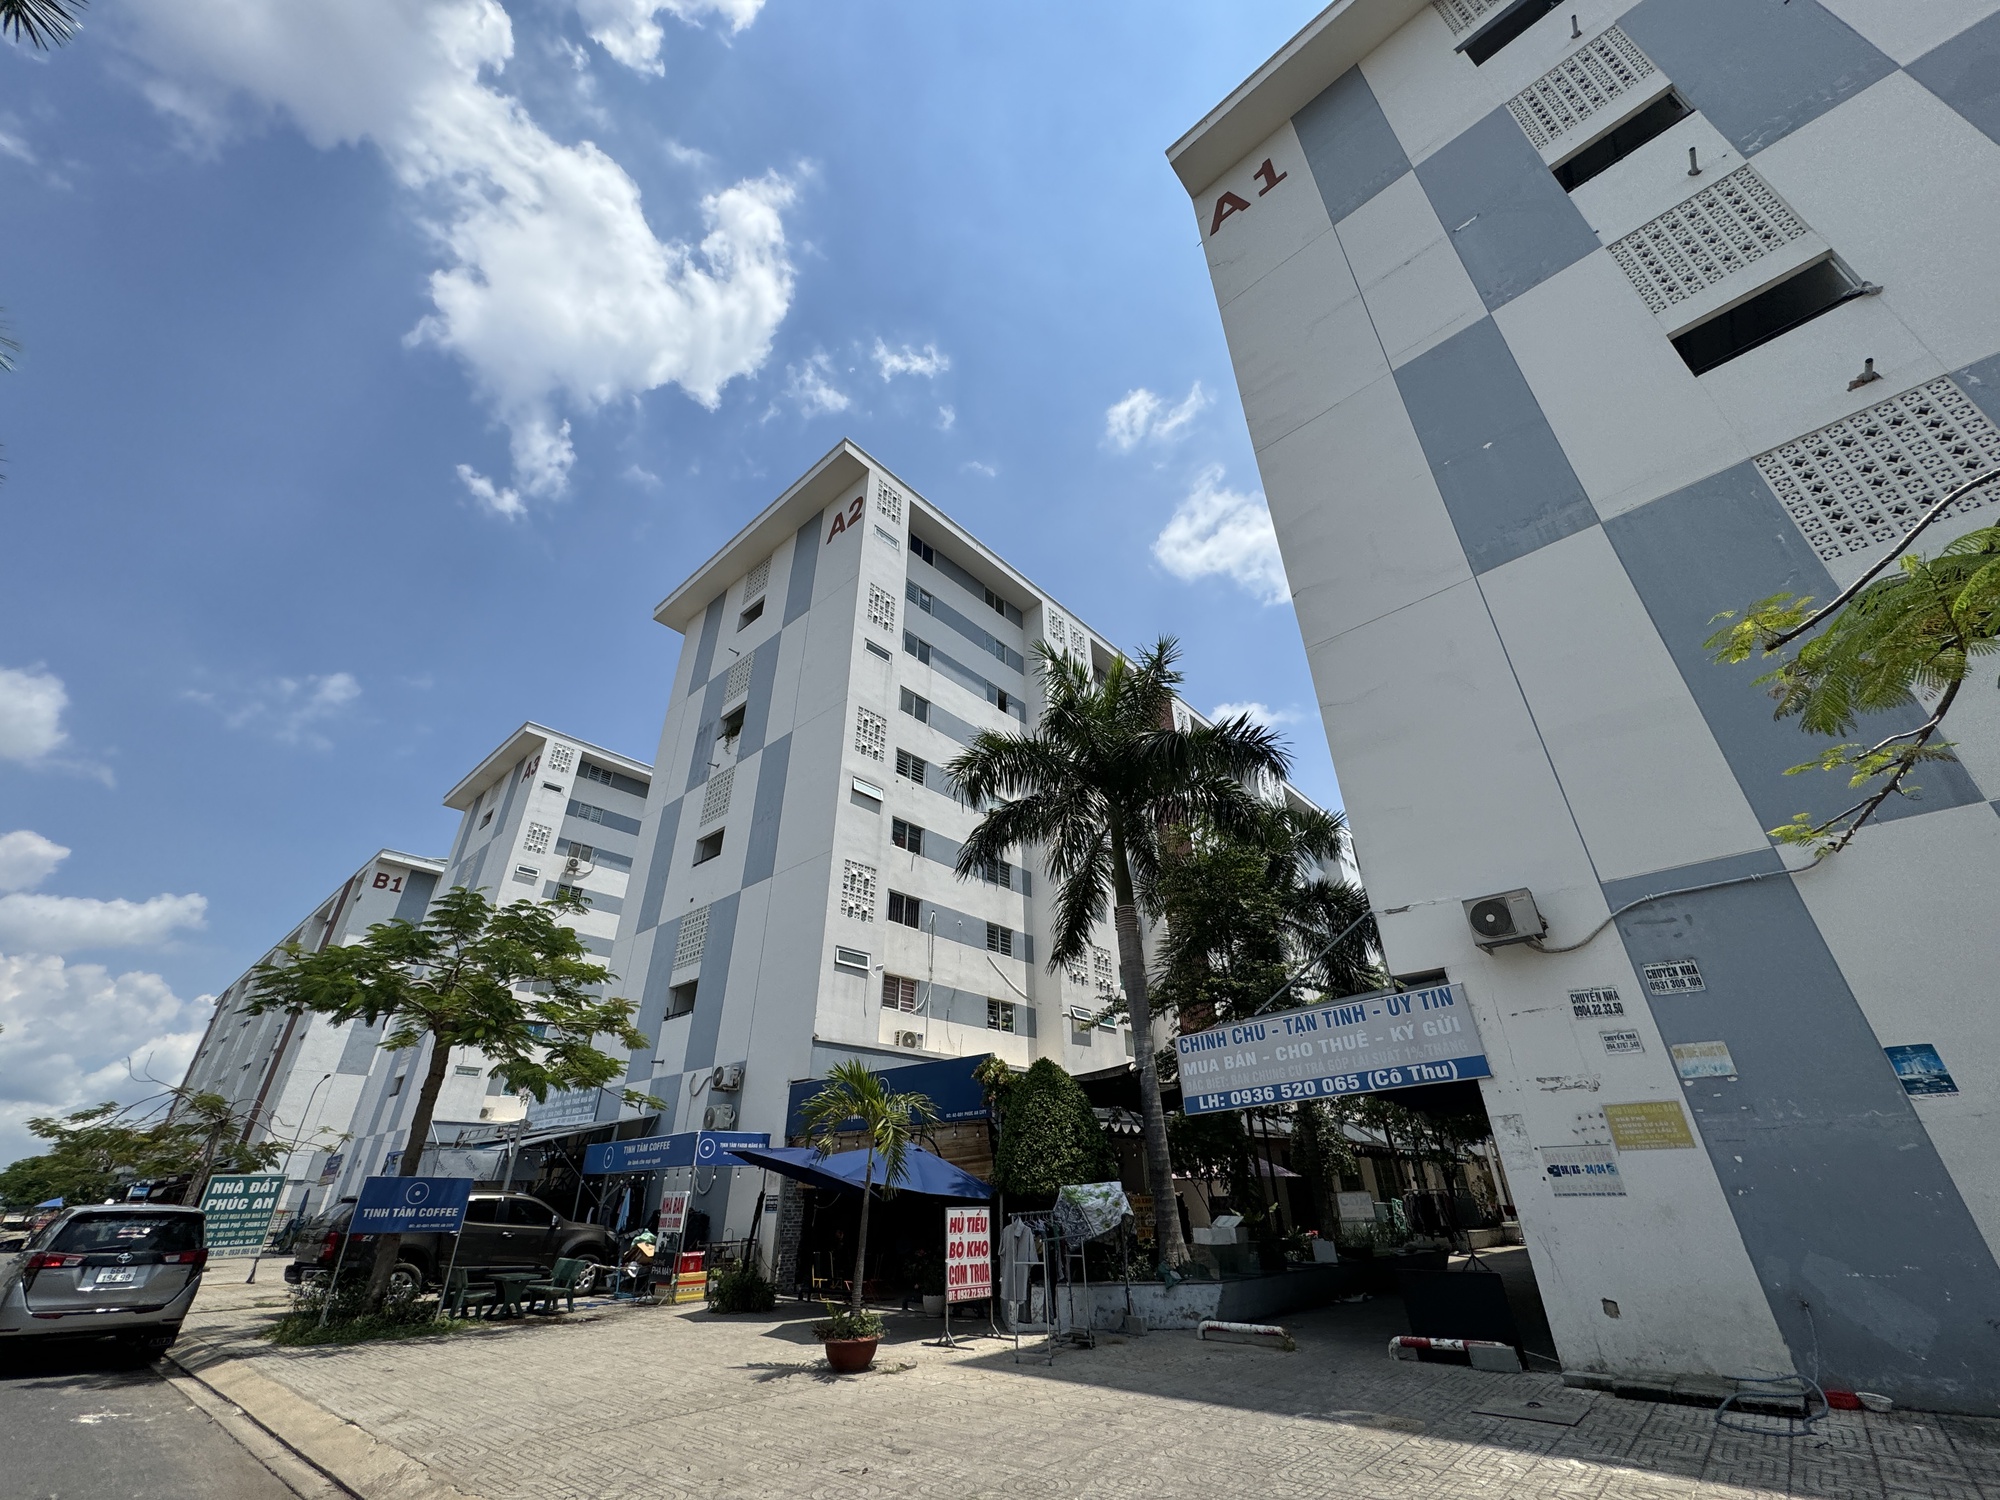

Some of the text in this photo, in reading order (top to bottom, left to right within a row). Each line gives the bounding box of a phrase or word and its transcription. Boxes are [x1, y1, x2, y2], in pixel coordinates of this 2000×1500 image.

[1210, 158, 1288, 236] A1
[826, 496, 864, 545] A2
[521, 756, 541, 784] A3
[372, 872, 402, 893] B1
[1650, 981, 1669, 990] 0931
[1670, 979, 1686, 988] 309
[1688, 977, 1702, 986] 109
[1184, 1058, 1220, 1076] MUA
[1224, 1050, 1258, 1070] BÁN
[1276, 1042, 1314, 1061] CHO
[1318, 1029, 1370, 1054] THUÊ
[1390, 1020, 1414, 1042] KÝ
[1422, 1014, 1462, 1037] GỬI
[1252, 1066, 1286, 1083] CHUNG
[1198, 1060, 1458, 1110] LH: 0936 520 065 (Cô Thu)
[650, 1140, 670, 1152] COFFEE
[1584, 1164, 1606, 1176] 24/24
[211, 1178, 280, 1194] NHÀ ĐẤT
[204, 1196, 274, 1210] PHÚC AN
[364, 1206, 459, 1220] TỊNH TÂM COFFEE
[949, 1209, 988, 1234] HỦ TIẾU
[966, 1240, 988, 1258] KHO
[949, 1261, 990, 1286] CƠM TRƯA
